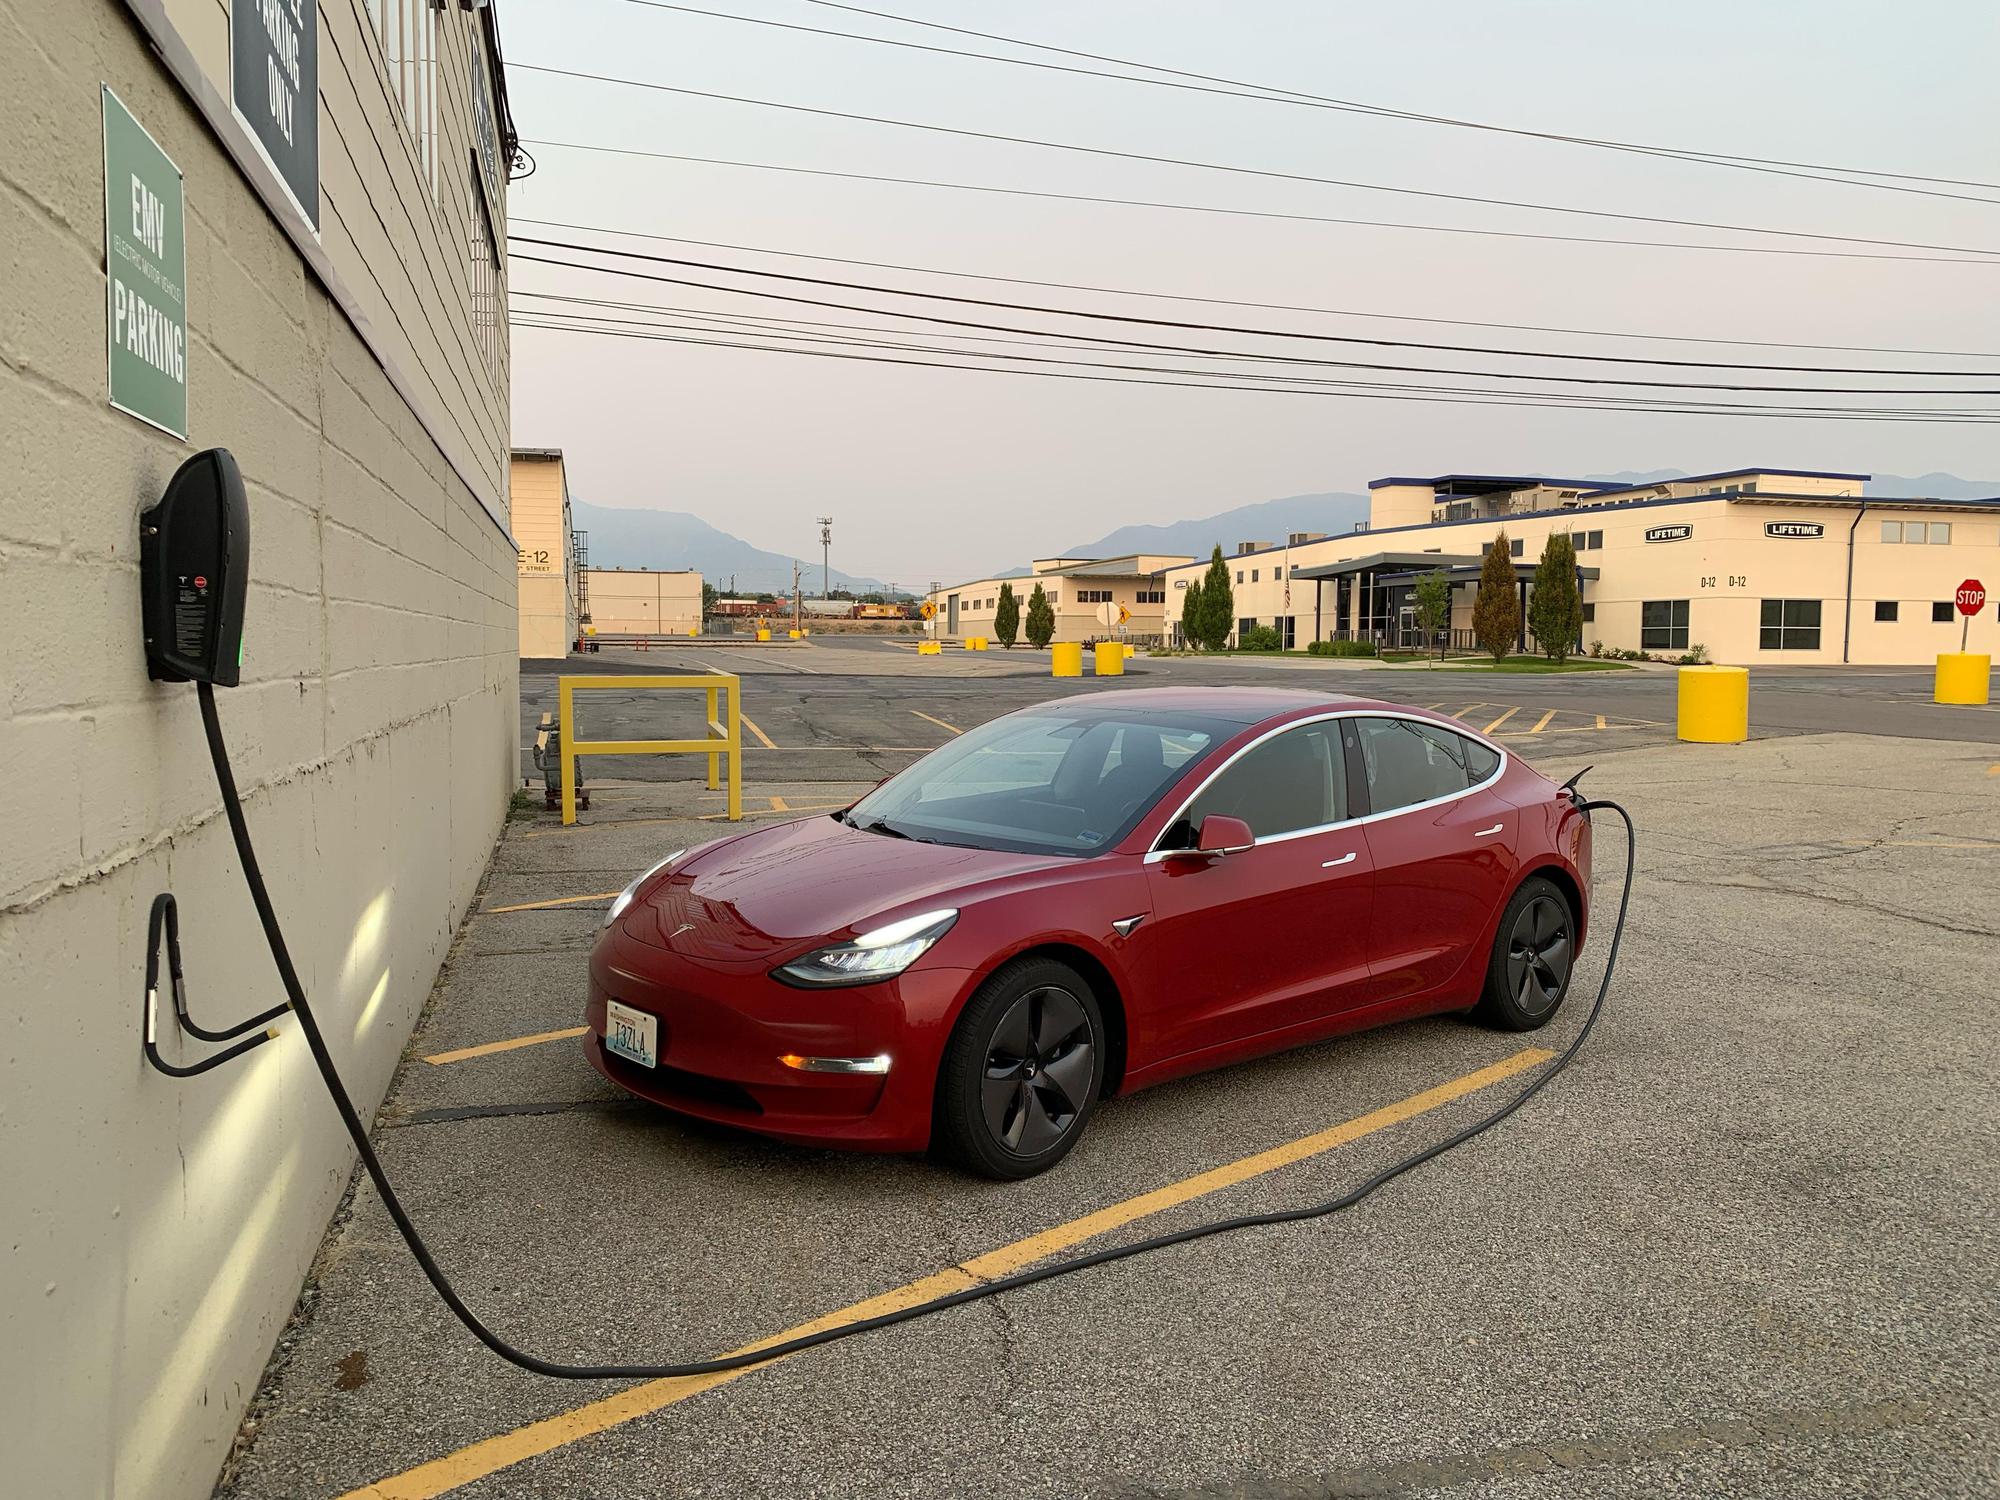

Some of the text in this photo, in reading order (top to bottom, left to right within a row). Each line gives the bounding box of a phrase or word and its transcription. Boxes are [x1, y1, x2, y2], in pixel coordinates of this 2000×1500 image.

[256, 0, 299, 93] ARKING
[268, 53, 293, 148] ONLY
[131, 173, 164, 260] EMV
[115, 278, 183, 384] PARKING
[1650, 527, 1687, 540] LIFETIME
[1772, 524, 1819, 535] LIFETIME
[1700, 576, 1716, 588] D-12
[1728, 575, 1747, 587] D-12
[1957, 590, 1984, 605] STOP
[615, 1021, 646, 1056] T3ZLA
